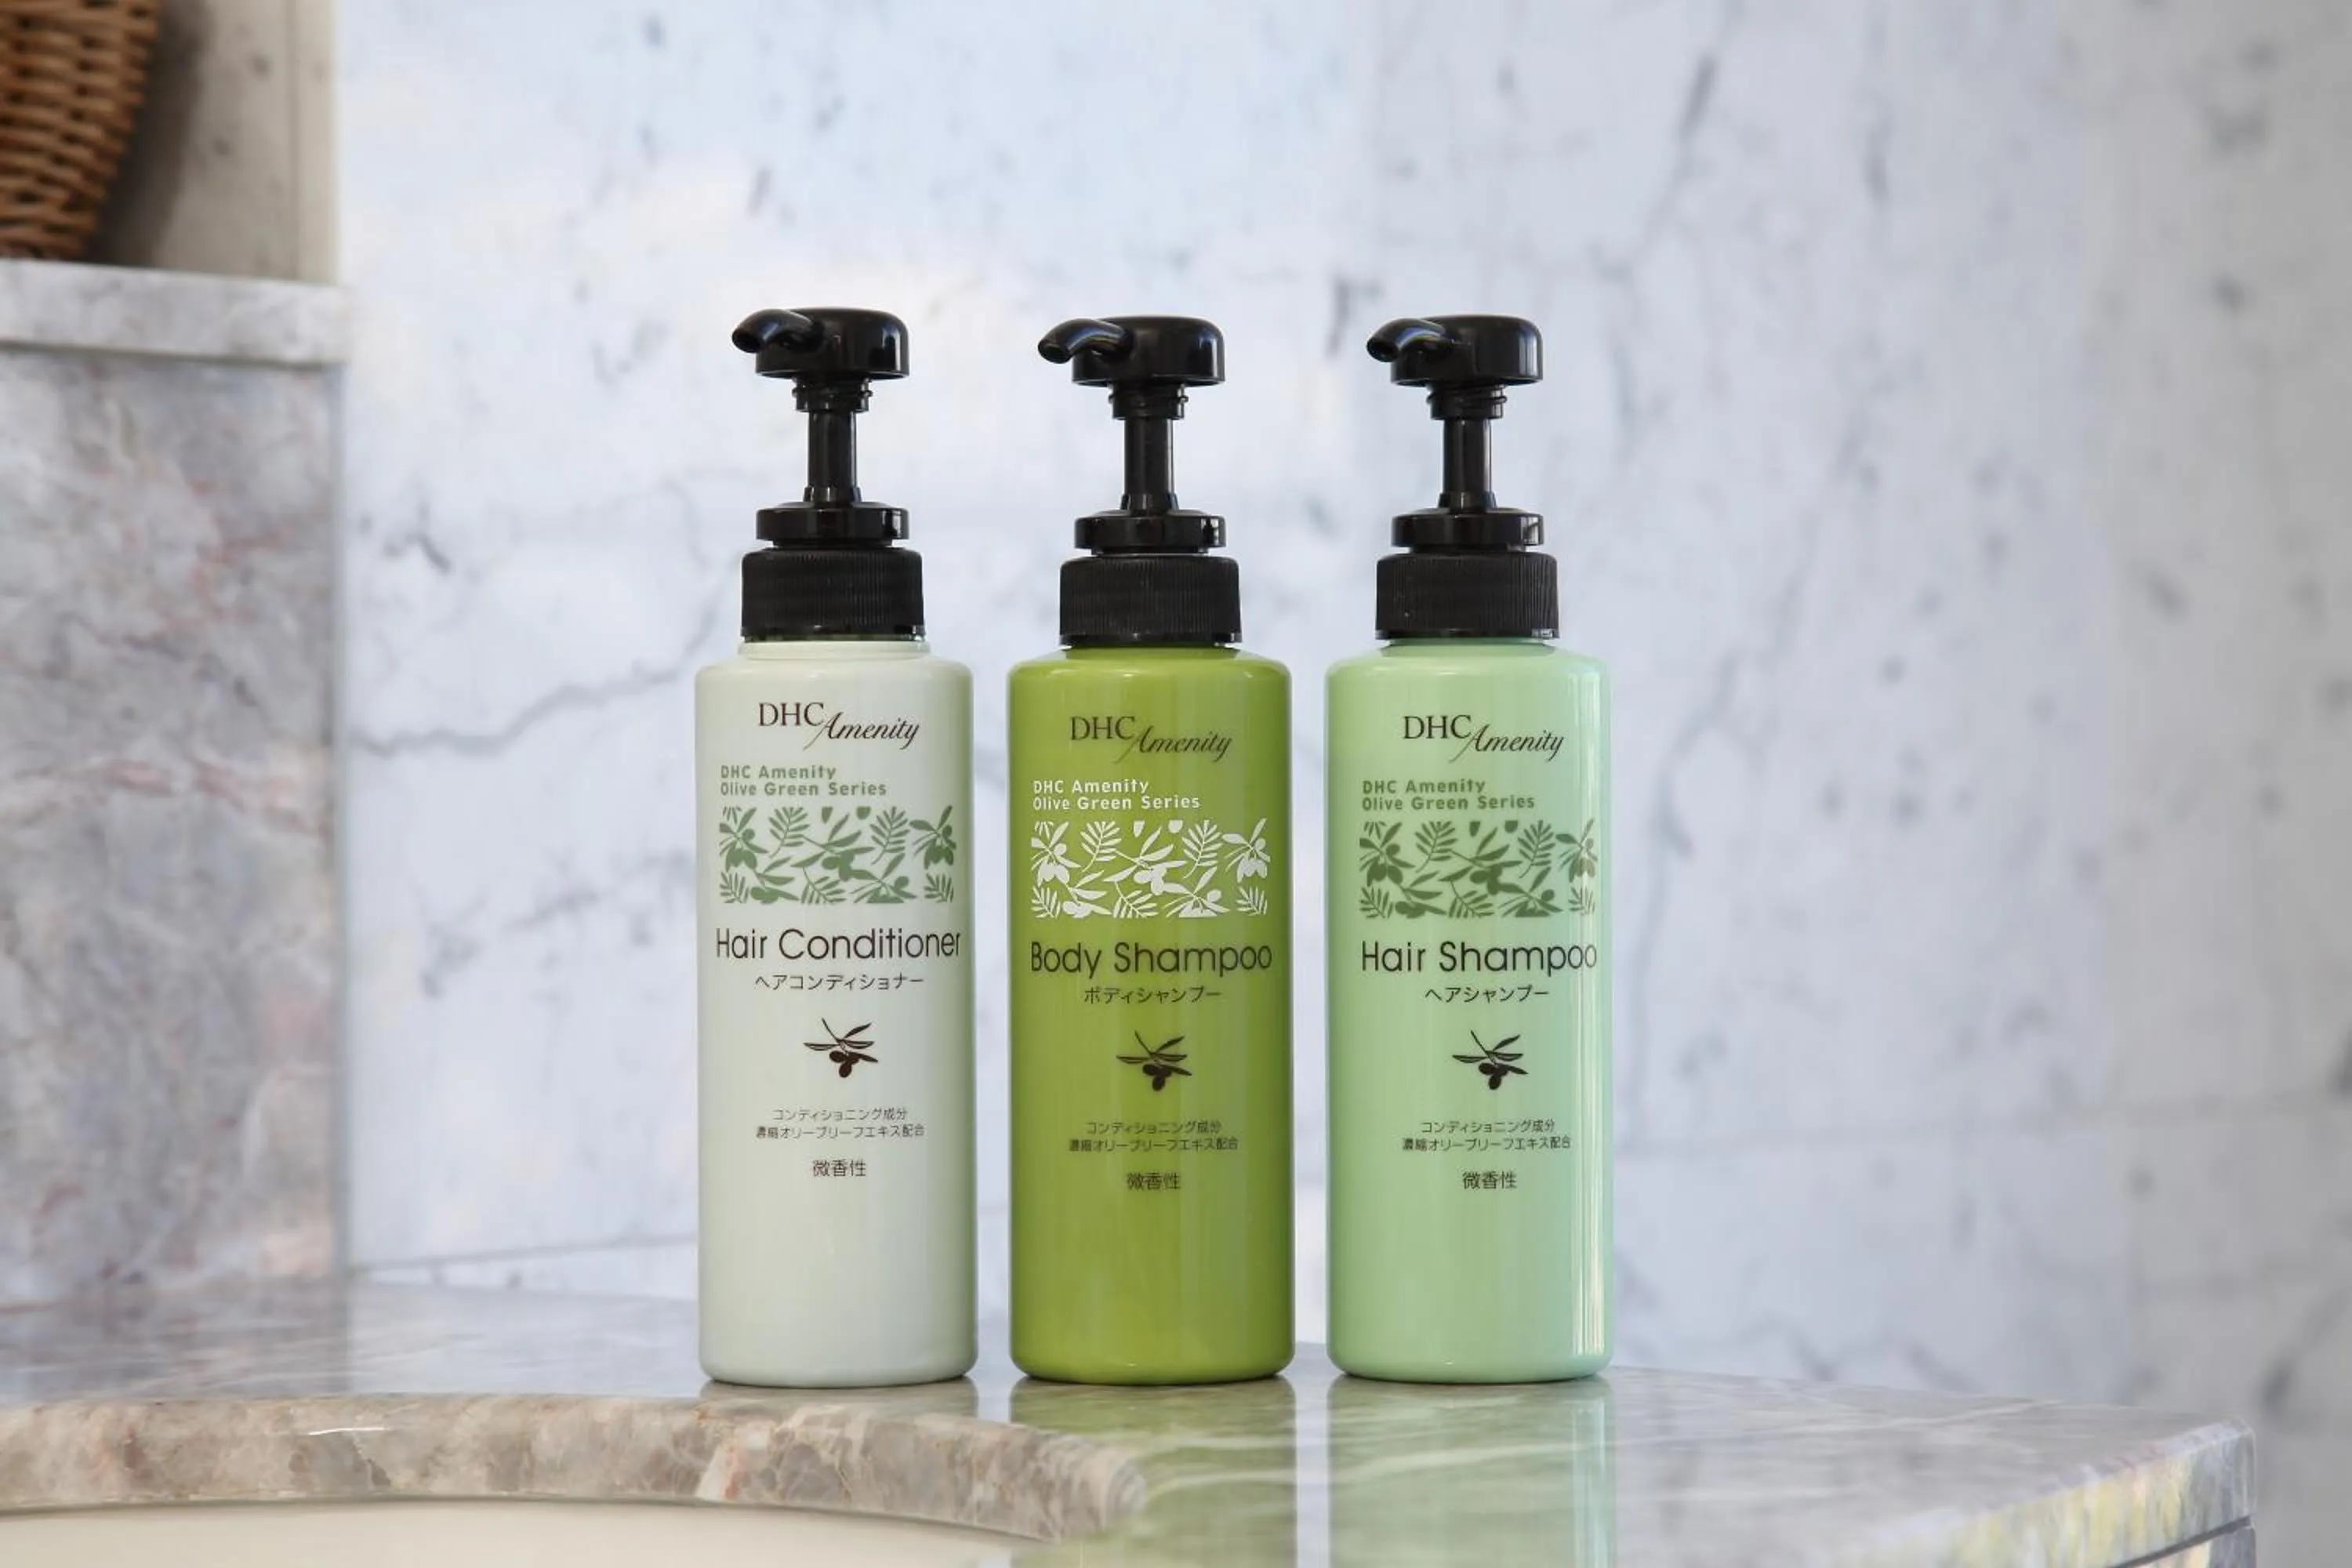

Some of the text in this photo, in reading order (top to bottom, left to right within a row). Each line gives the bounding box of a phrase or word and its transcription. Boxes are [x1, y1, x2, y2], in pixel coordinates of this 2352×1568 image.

[758, 702, 920, 750] DHC Amenity
[1071, 716, 1233, 764] DHC Amenity
[1403, 714, 1565, 764] DHC Amenity
[720, 765, 837, 779] DHC Amenity
[720, 782, 887, 796] Olive Green Series
[1033, 779, 1149, 794] DHC Amenity
[1362, 779, 1486, 794] DHC Amenity
[1033, 794, 1201, 810] Olive Green Series
[1361, 794, 1535, 811] Olive Green Series
[716, 927, 961, 960] Hair Conditioner
[1030, 942, 1272, 978] Body Shampoo
[1361, 941, 1598, 978] Hair Shampoo
[754, 972, 924, 991] ヘアコンディショナー
[1083, 985, 1222, 1004] ボディシャンプー
[1425, 984, 1550, 1004] ヘアシャンプー
[774, 1106, 909, 1121] コンディショニング成分
[1086, 1119, 1223, 1135] コンディショニング成分
[1421, 1118, 1555, 1134] コンディショニング成分
[812, 1158, 867, 1178] 微香性
[1126, 1171, 1181, 1191] 微香性
[1461, 1171, 1518, 1190] 微香性
